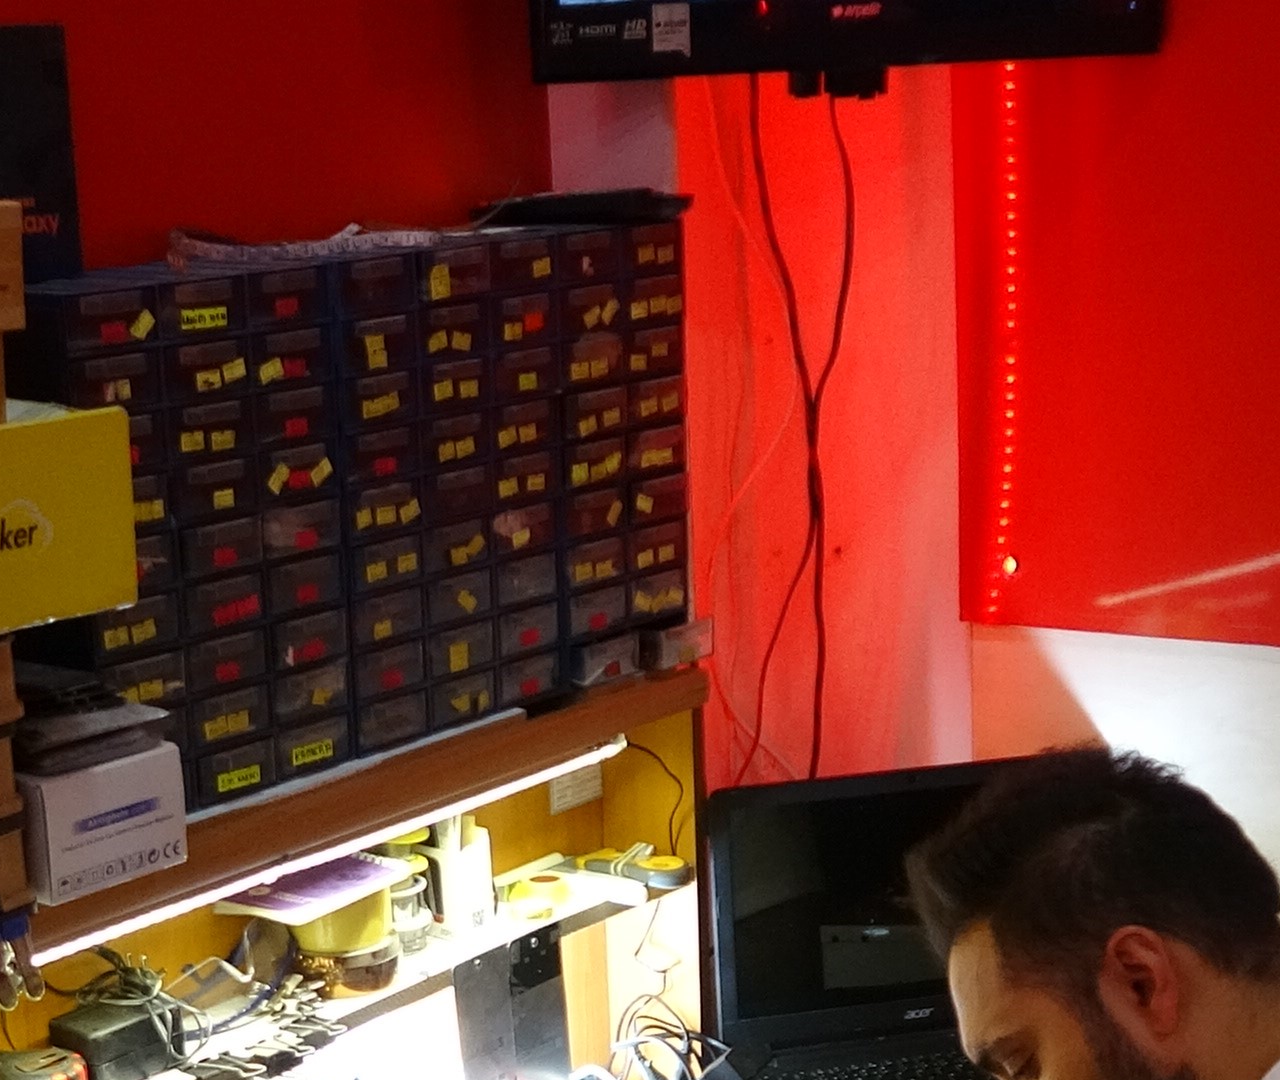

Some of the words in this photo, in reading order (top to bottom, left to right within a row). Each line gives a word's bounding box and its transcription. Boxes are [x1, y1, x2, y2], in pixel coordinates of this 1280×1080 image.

[580, 23, 616, 35] HDMI
[24, 213, 59, 235] axy
[904, 1007, 934, 1020] acer
